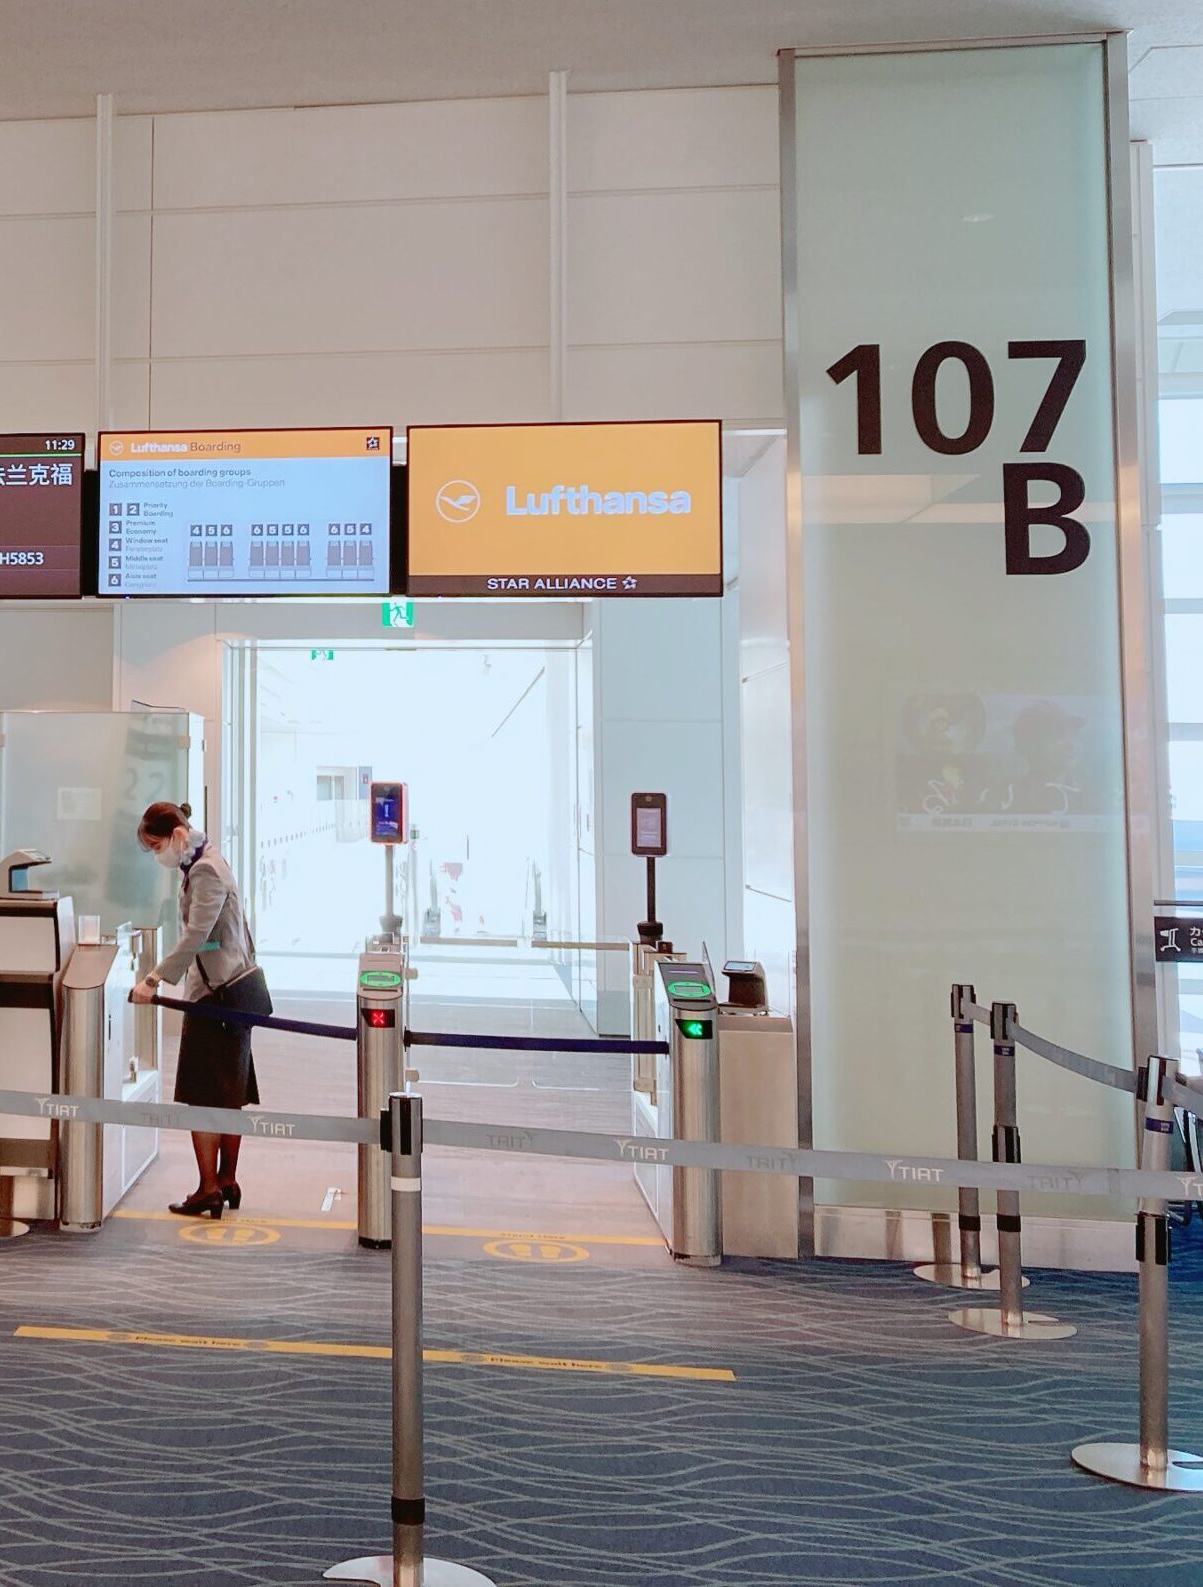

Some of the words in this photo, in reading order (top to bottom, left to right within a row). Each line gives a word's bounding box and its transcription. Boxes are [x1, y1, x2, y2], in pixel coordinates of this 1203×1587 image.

[826, 339, 1087, 455] 107
[45, 440, 75, 451] 11:29
[190, 441, 241, 453] Boarding
[109, 469, 166, 479] Composition
[167, 469, 177, 477] of
[178, 468, 218, 478] boarding
[219, 469, 251, 479] groups
[506, 485, 691, 515] Lufthansa
[1003, 462, 1091, 575] B
[487, 578, 529, 590] STAR
[534, 577, 617, 590] ALLIANCE
